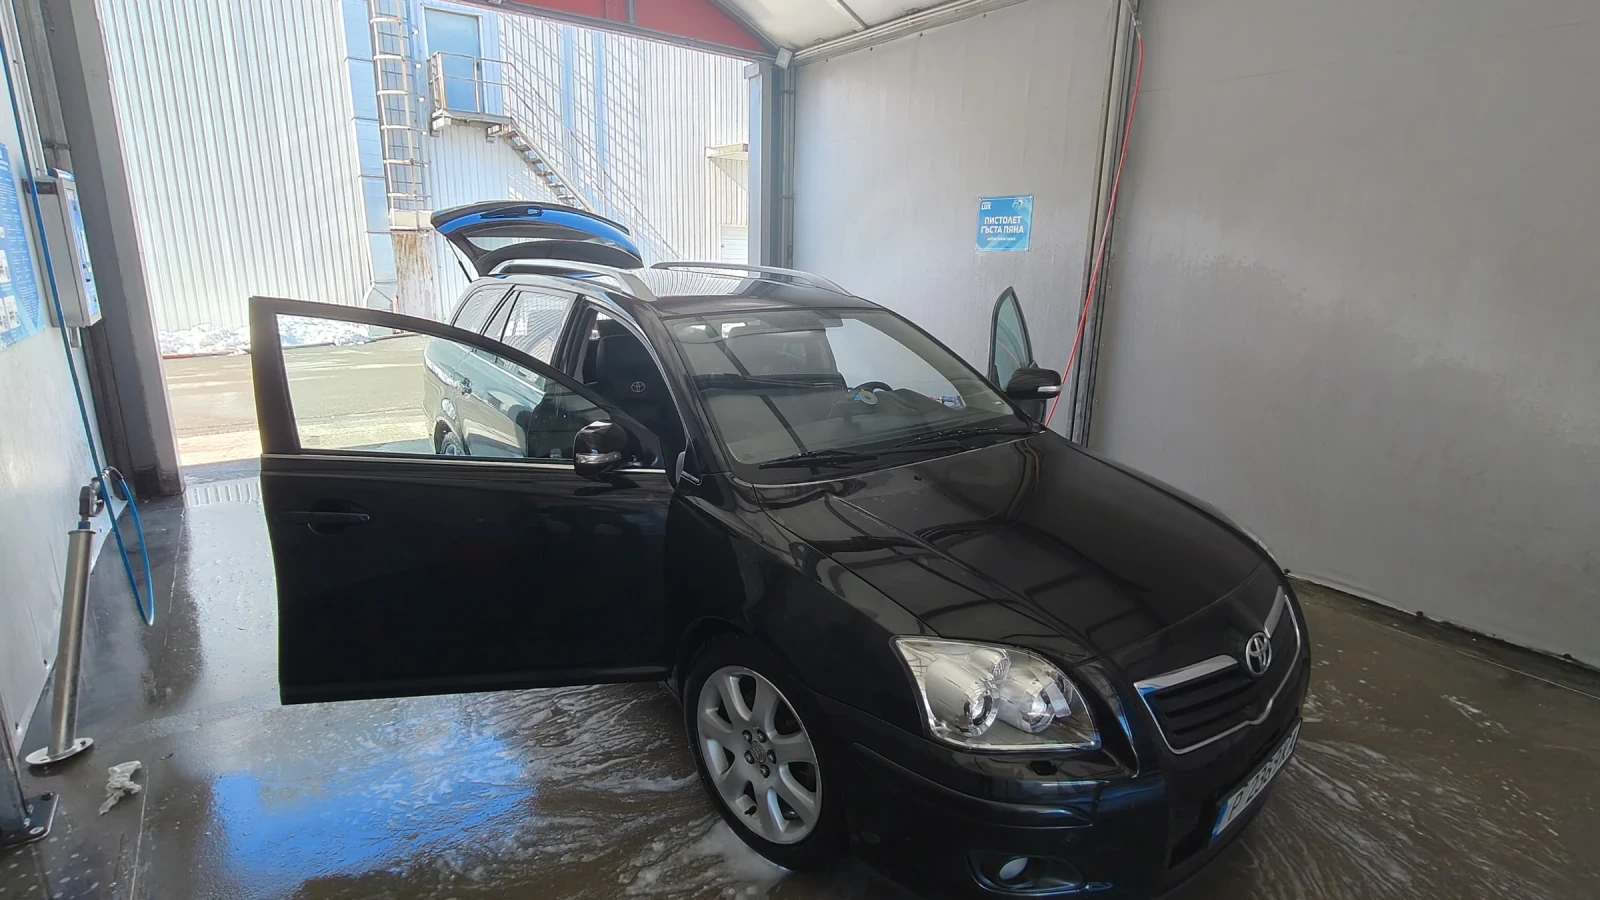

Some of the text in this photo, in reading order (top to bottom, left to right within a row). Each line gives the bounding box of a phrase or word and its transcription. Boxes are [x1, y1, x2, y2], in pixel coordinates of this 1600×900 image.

[984, 216, 1022, 224] ПИСТОЛЕТ
[981, 225, 1024, 234] ГЪСТА ПЯНА
[1227, 790, 1244, 821] P
